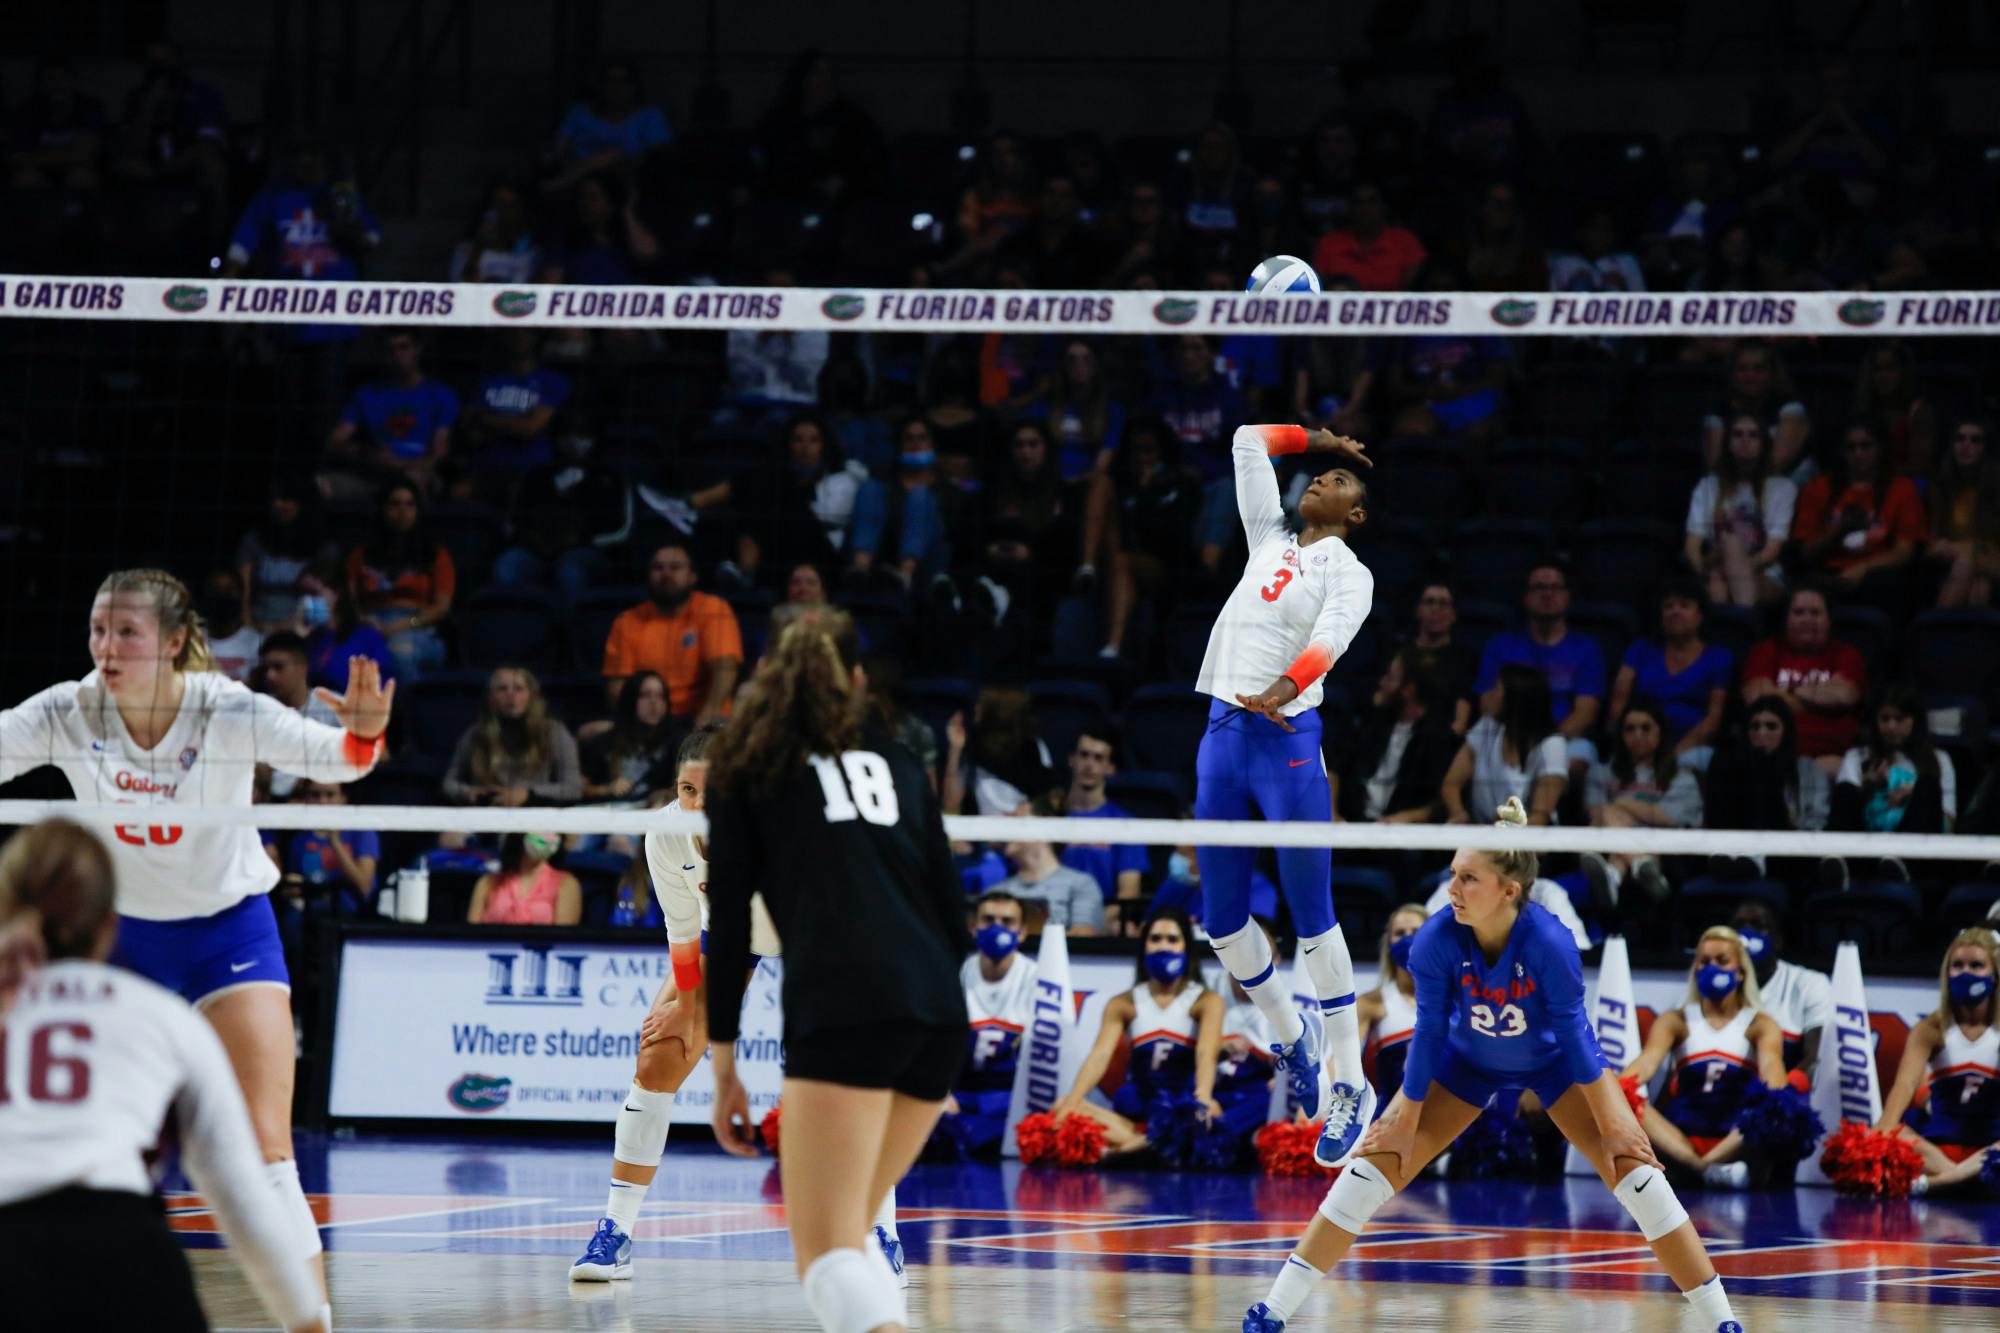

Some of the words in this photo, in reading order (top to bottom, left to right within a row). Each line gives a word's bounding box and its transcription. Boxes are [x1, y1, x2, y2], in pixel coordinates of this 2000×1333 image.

[14, 282, 124, 310] GATORS
[219, 286, 336, 313] FLORIDA
[345, 289, 454, 315] GATORS
[548, 292, 664, 317] FLORIDA
[674, 294, 782, 319] GATORS
[878, 295, 996, 321] FLORIDA
[1004, 297, 1113, 322] GATORS
[1550, 299, 1672, 325] FLORIDA
[1681, 298, 1796, 325] GATORS
[1897, 298, 2000, 325] FLORID
[1210, 299, 1330, 324] FLORIDA
[1339, 300, 1451, 325] GATORS
[1261, 568, 1293, 603] 3
[806, 749, 901, 828] 18
[1470, 1003, 1529, 1037] 23
[1597, 996, 1627, 1071] FLO
[453, 1023, 537, 1057] Where
[544, 1025, 641, 1061] student
[973, 1029, 1007, 1071] F
[1151, 1040, 1175, 1072] F
[1701, 1061, 1729, 1094] F
[1836, 1004, 1872, 1127] FLORID
[517, 1087, 571, 1104] OFFICIAL
[577, 1088, 628, 1105] PARTNE
[1959, 1075, 1986, 1105] F
